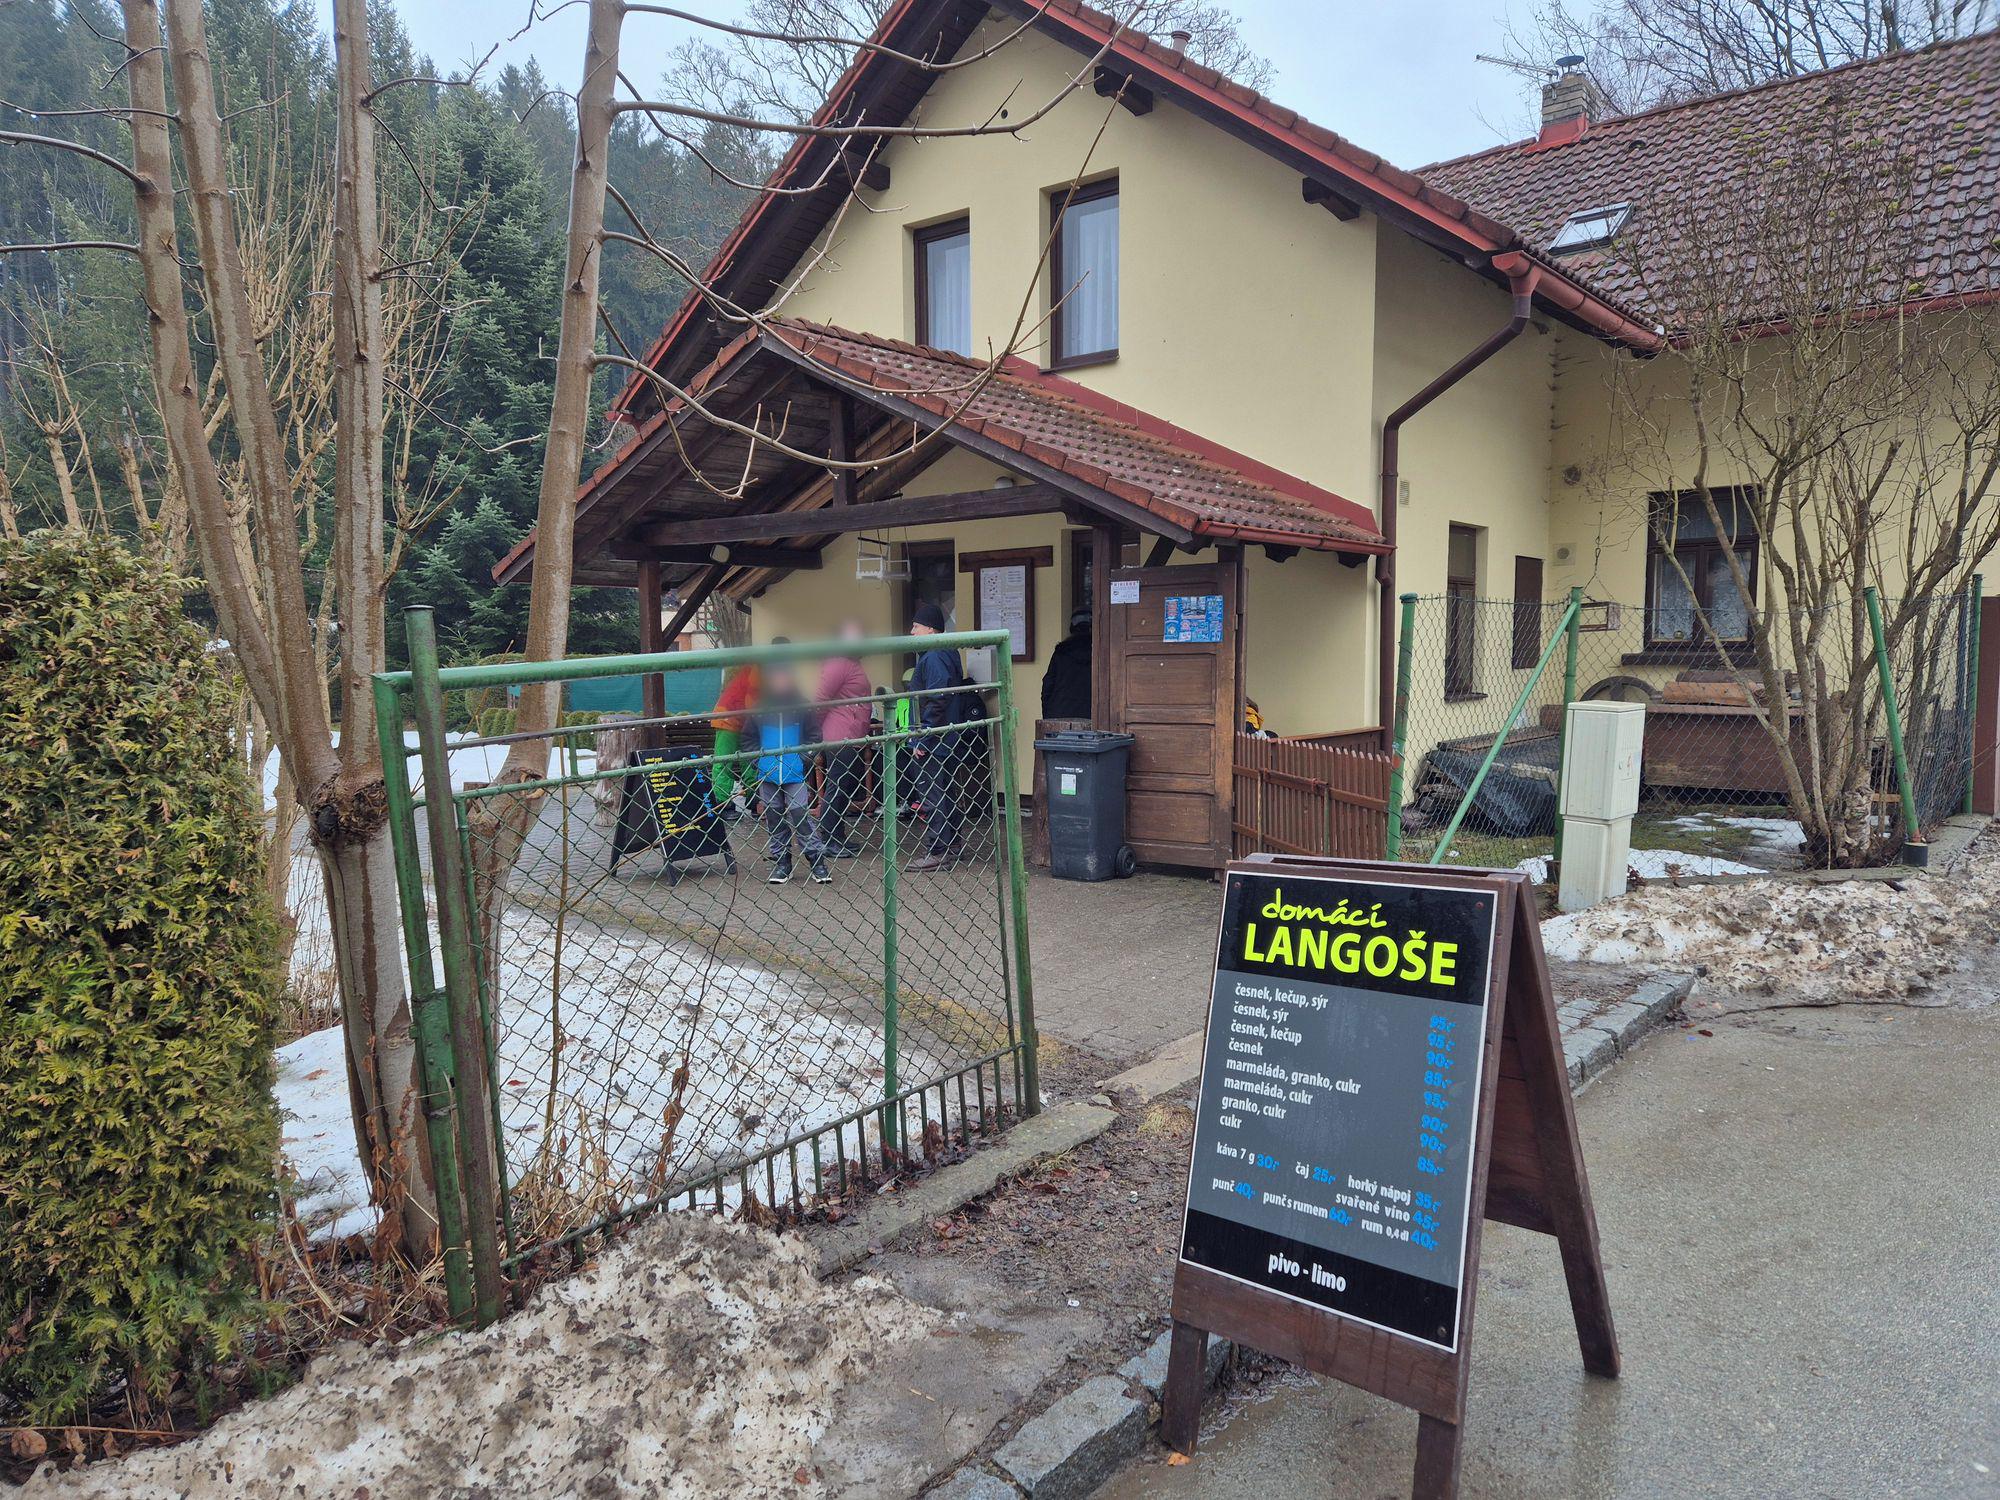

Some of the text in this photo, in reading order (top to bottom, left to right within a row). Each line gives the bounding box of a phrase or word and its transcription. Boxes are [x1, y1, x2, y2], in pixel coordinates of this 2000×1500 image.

[1262, 888, 1387, 928] domácí
[1244, 922, 1459, 986] LANGOŠE
[1235, 982, 1272, 1001] česnek,
[1275, 988, 1309, 1008] kečup,
[1311, 994, 1328, 1011] sýr
[1233, 1001, 1270, 1021] česnek,
[1272, 1008, 1289, 1023] sýr
[1228, 1037, 1263, 1056] česnek
[1231, 1019, 1268, 1039] česnek,
[1270, 1025, 1302, 1046] kečup
[1224, 1077, 1286, 1101] marmeláda,
[1288, 1089, 1313, 1105] cukr
[1226, 1059, 1288, 1082] marmeláda,
[1291, 1071, 1333, 1091] granko,
[1335, 1079, 1361, 1094] cukr
[1219, 1113, 1242, 1129] cukr
[1221, 1096, 1260, 1116] granko,
[1262, 1104, 1286, 1119] cukr
[1216, 1141, 1238, 1158] káva
[1240, 1148, 1247, 1159] 7
[1248, 1152, 1255, 1164] g
[1295, 1161, 1309, 1179] čaj
[1348, 1174, 1377, 1196] horký
[1380, 1185, 1411, 1206] nápoj
[1212, 1177, 1235, 1192] punč
[1262, 1192, 1287, 1207] punč
[1287, 1199, 1292, 1209] s
[1293, 1200, 1328, 1219] rumem
[1361, 1219, 1383, 1234] rum
[1335, 1193, 1380, 1214] svařené
[1384, 1205, 1410, 1222] víno
[1268, 1252, 1300, 1277] pivo
[1311, 1263, 1346, 1292] limo
